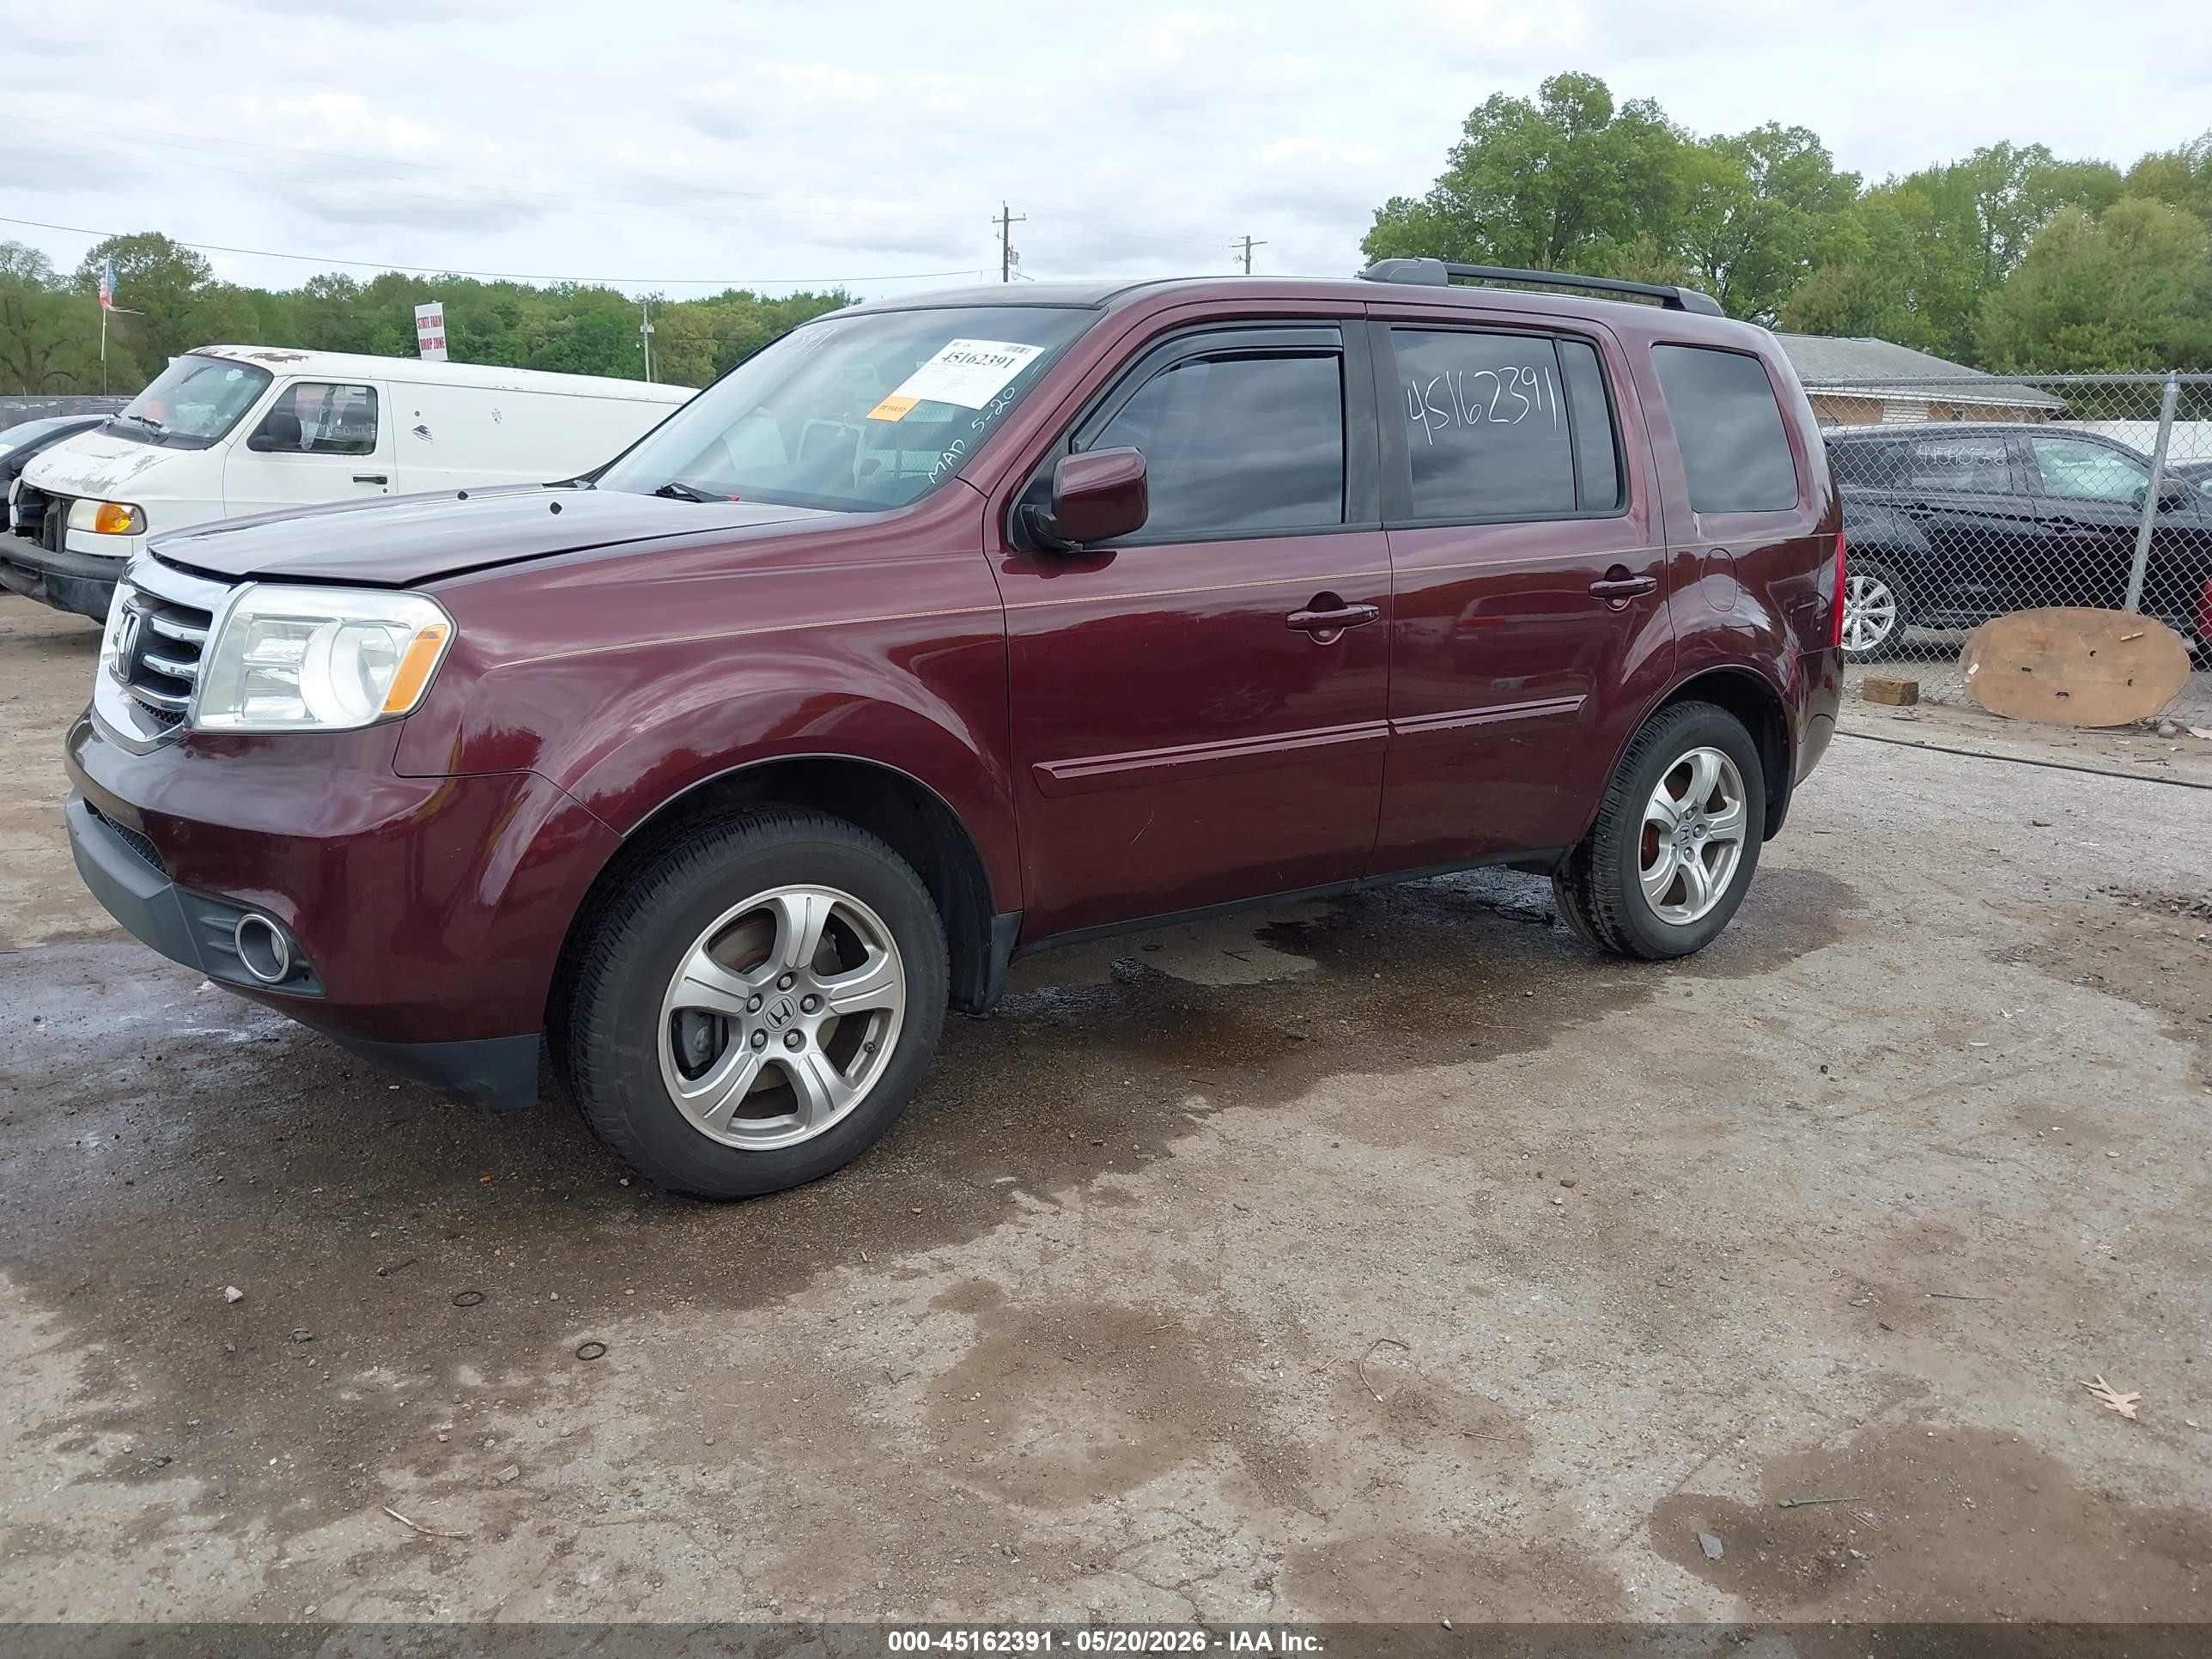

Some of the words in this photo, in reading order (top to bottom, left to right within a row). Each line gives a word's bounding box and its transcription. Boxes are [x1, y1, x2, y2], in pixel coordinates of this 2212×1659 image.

[417, 317, 430, 330] STATE
[430, 315, 442, 327] FARM
[420, 337, 433, 350] DROP
[433, 336, 446, 349] ZONE
[941, 350, 1017, 368] 45162391
[1407, 366, 1557, 445] 45162391
